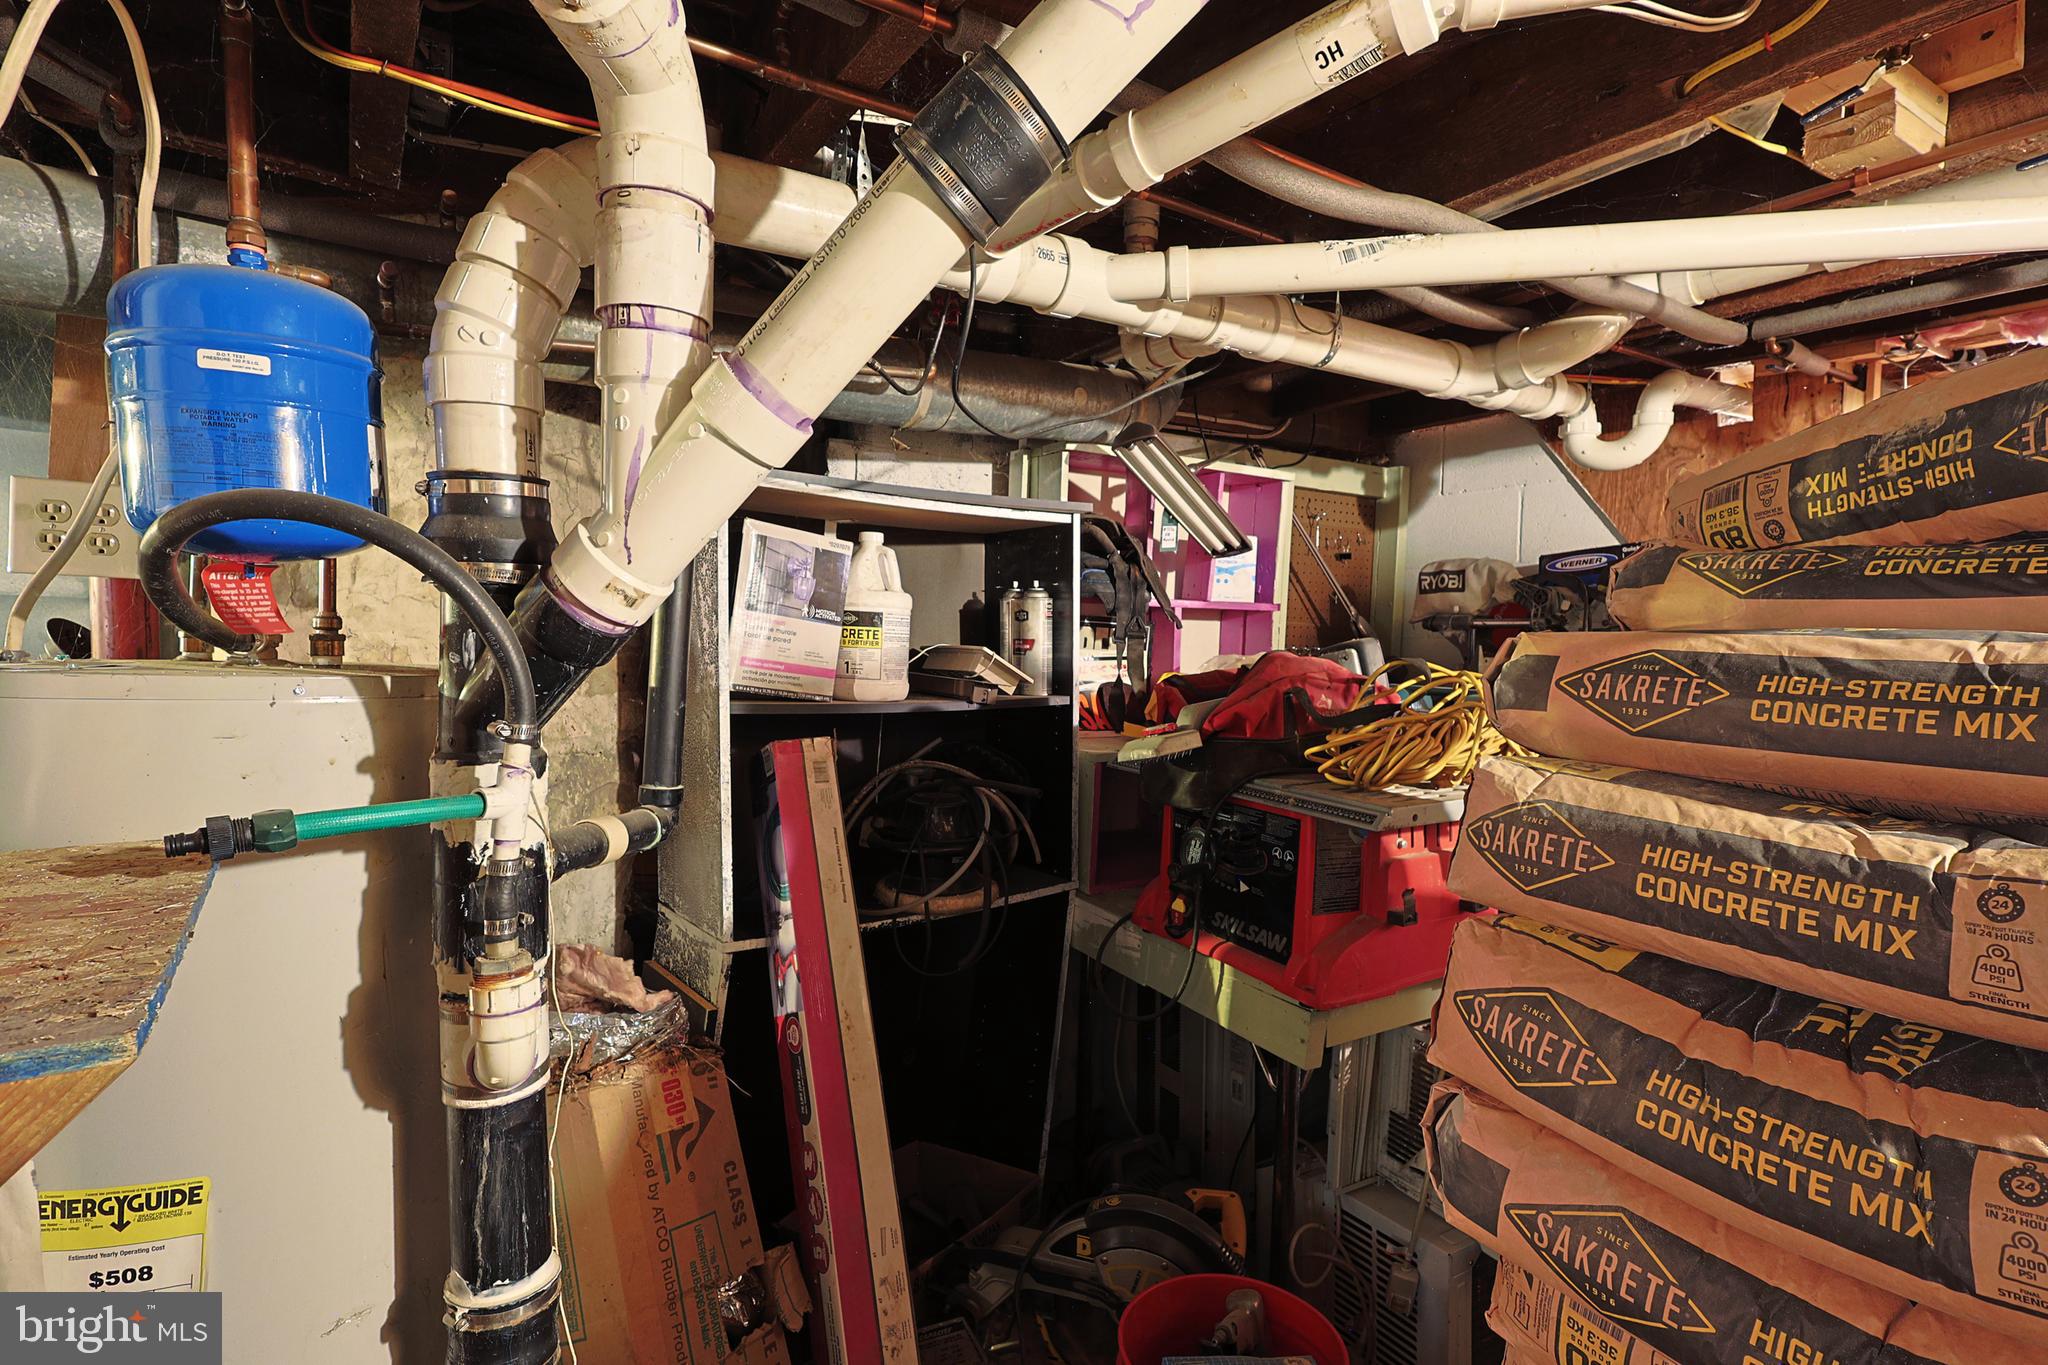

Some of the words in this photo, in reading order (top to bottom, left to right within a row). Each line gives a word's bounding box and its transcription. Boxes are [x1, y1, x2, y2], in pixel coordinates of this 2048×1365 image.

[812, 200, 872, 271] ASTM-D-2665
[181, 408, 220, 416] EXPANSION
[201, 421, 236, 429] WARNING
[1806, 466, 1848, 498] MIX
[1808, 458, 1976, 520] HIGH-STRENGTH
[1706, 513, 1718, 523] KG
[1720, 506, 1740, 519] 36.3
[1709, 519, 1737, 530] POUNDS
[1710, 526, 1748, 550] 80
[1560, 557, 1602, 568] WERNER
[1699, 552, 1826, 570] SAKRETE
[1864, 556, 2048, 576] CONCRETE
[1420, 574, 1463, 590] RYOBI
[842, 628, 879, 640] CRETE
[848, 638, 880, 647] FORTIFIER
[1632, 663, 1661, 672] SINCE
[1578, 672, 1706, 707] SAKRETE
[1756, 674, 2041, 708] HIGH-STRENGTH
[1622, 707, 1648, 717] 1936
[1750, 699, 1941, 736] CONCRETE
[1953, 710, 2039, 743] MIX
[1522, 814, 1549, 827] SINCE
[1480, 820, 1592, 873] SAKRETE
[1514, 863, 1539, 876] 1936
[1640, 843, 1920, 922] HIGH-STRENGTH
[1991, 900, 2009, 910] 24
[1635, 872, 1820, 938] CONCRETE
[1833, 914, 1918, 962] MIX
[1212, 911, 1287, 954] SKILSAW
[1980, 929, 1992, 938] 24
[1995, 932, 2034, 944] HOURS
[1980, 962, 2016, 978] 4000
[1989, 974, 2006, 984] PSI
[1968, 991, 2030, 1010] STRENGTH
[1522, 1003, 1552, 1023] SINCE
[1470, 996, 1596, 1086] SAKRETE
[1507, 1055, 1533, 1074] 1936
[1645, 1069, 1933, 1200] HIGH-STRENGTH
[1635, 1100, 1834, 1207] CONCRETE
[1849, 1182, 1935, 1248] MIX
[648, 1182, 660, 1201] by
[724, 1160, 746, 1230] CLASS
[2015, 1179, 2036, 1193] 24
[39, 1185, 203, 1220] ENERGYGUIDE
[1985, 1208, 1999, 1220] IN
[2002, 1212, 2016, 1224] 24
[652, 1206, 670, 1253] ATCO
[1596, 1226, 1630, 1250] SINCE
[68, 1253, 98, 1261] Estimated
[100, 1251, 118, 1260] Yearly
[119, 1246, 150, 1257] Operating
[1533, 1212, 1686, 1330] SAKRETE
[2006, 1254, 2047, 1274] 4000
[88, 1265, 154, 1289] $508
[2018, 1269, 2037, 1282] PSI
[662, 1258, 679, 1316] Rubber
[1584, 1282, 1616, 1307] 1936
[1567, 1315, 1585, 1338] KG
[1587, 1330, 1618, 1360] 36.3
